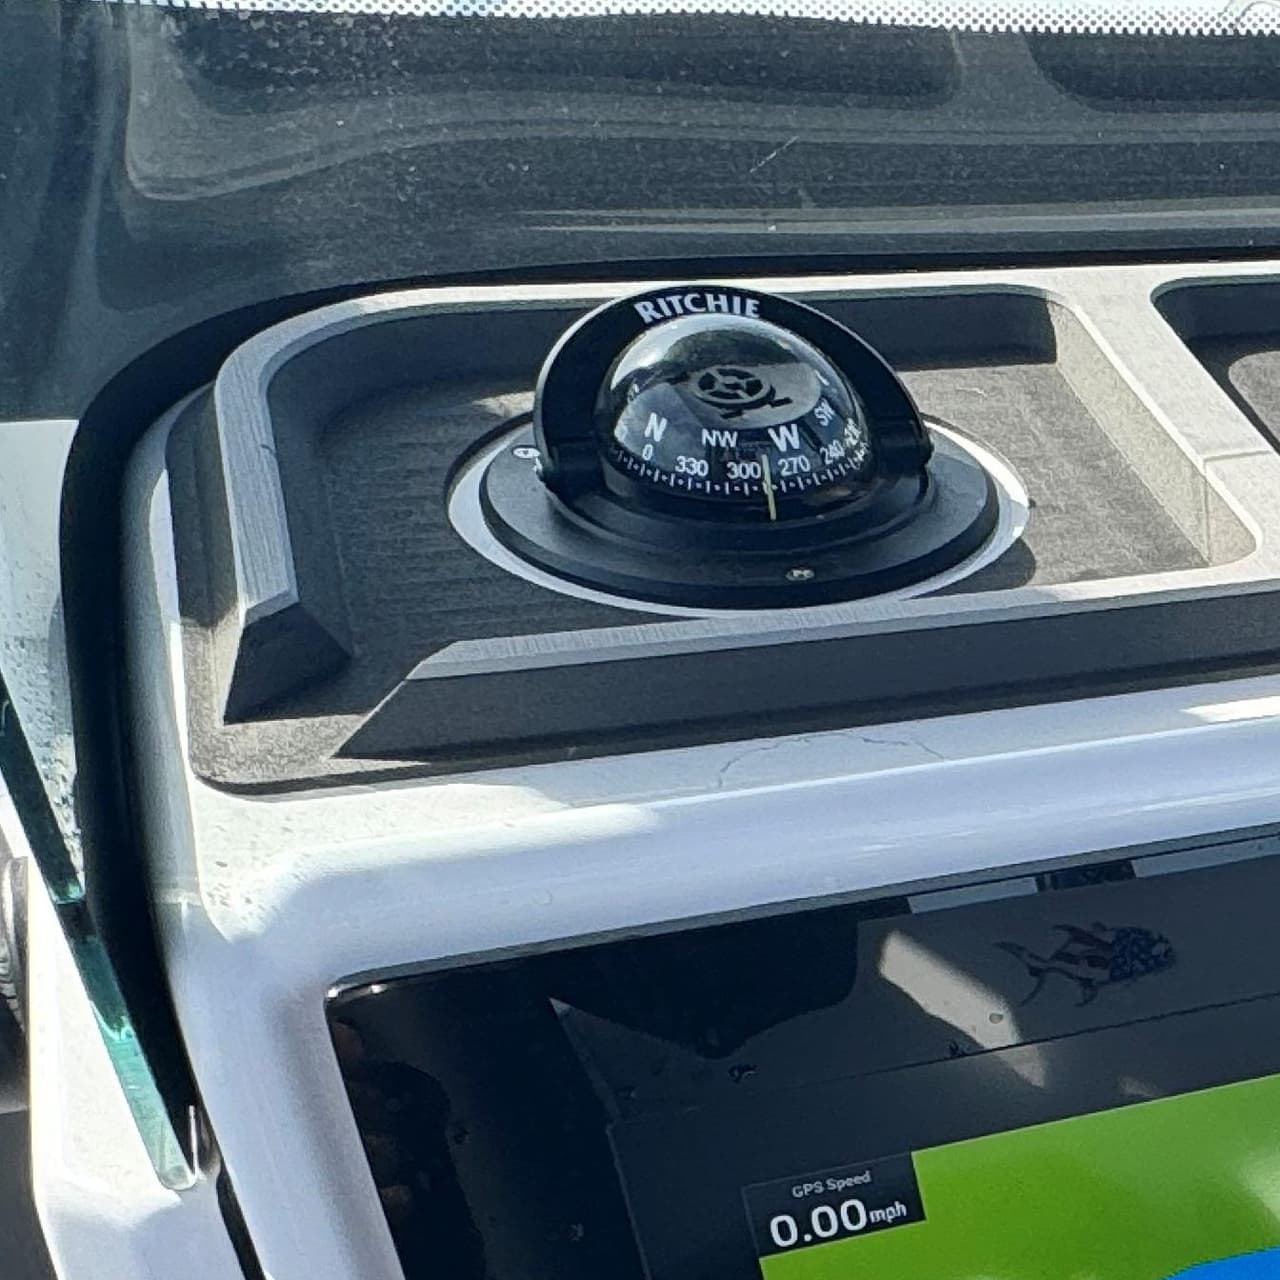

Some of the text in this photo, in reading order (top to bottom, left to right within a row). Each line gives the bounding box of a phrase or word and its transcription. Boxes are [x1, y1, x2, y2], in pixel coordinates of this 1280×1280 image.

[634, 294, 761, 325] RITCHIE
[644, 412, 668, 442] N
[701, 428, 738, 449] NW
[768, 423, 800, 452] W
[642, 444, 653, 461] 0
[675, 455, 709, 477] 330
[726, 461, 762, 480] 300
[777, 455, 810, 477] 270
[792, 1171, 872, 1198] GPS Speed
